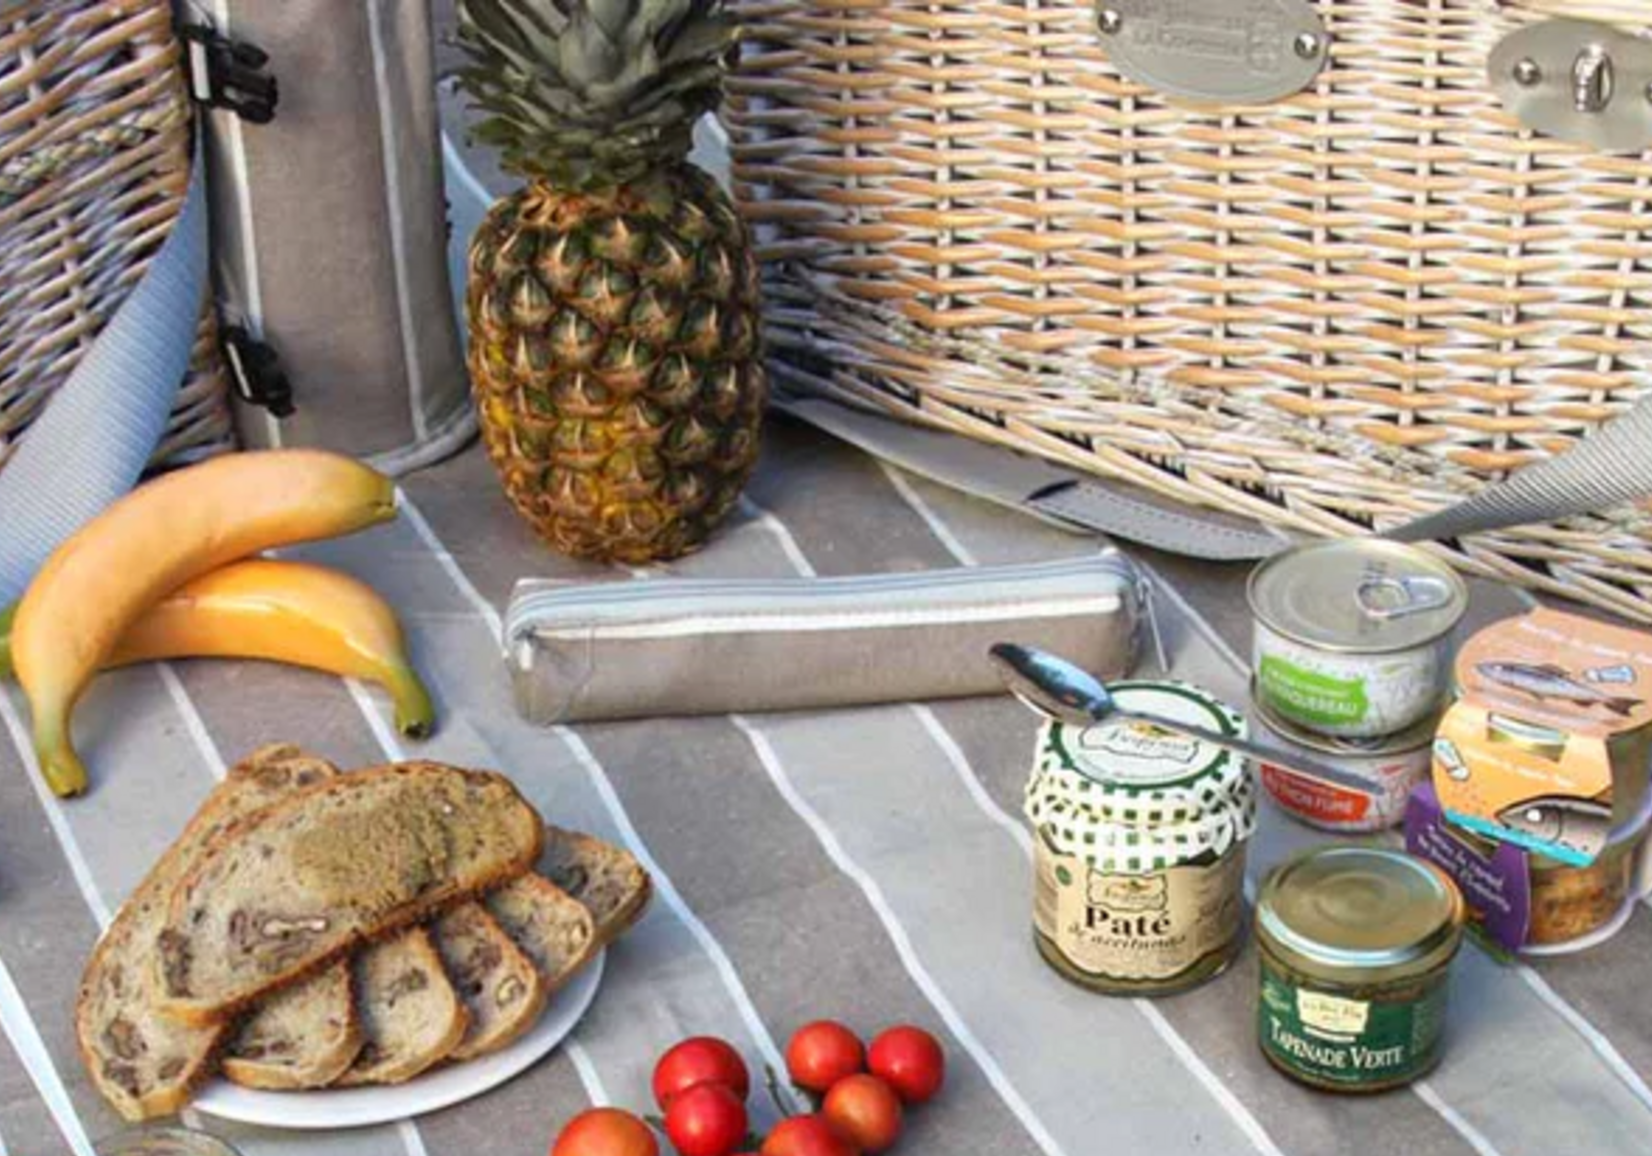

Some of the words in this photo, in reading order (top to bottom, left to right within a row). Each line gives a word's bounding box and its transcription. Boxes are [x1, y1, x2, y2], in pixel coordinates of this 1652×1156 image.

[1085, 905, 1170, 938] Paté
[1269, 1015, 1347, 1069] TAPENADE
[1350, 1044, 1405, 1070] VERTE
